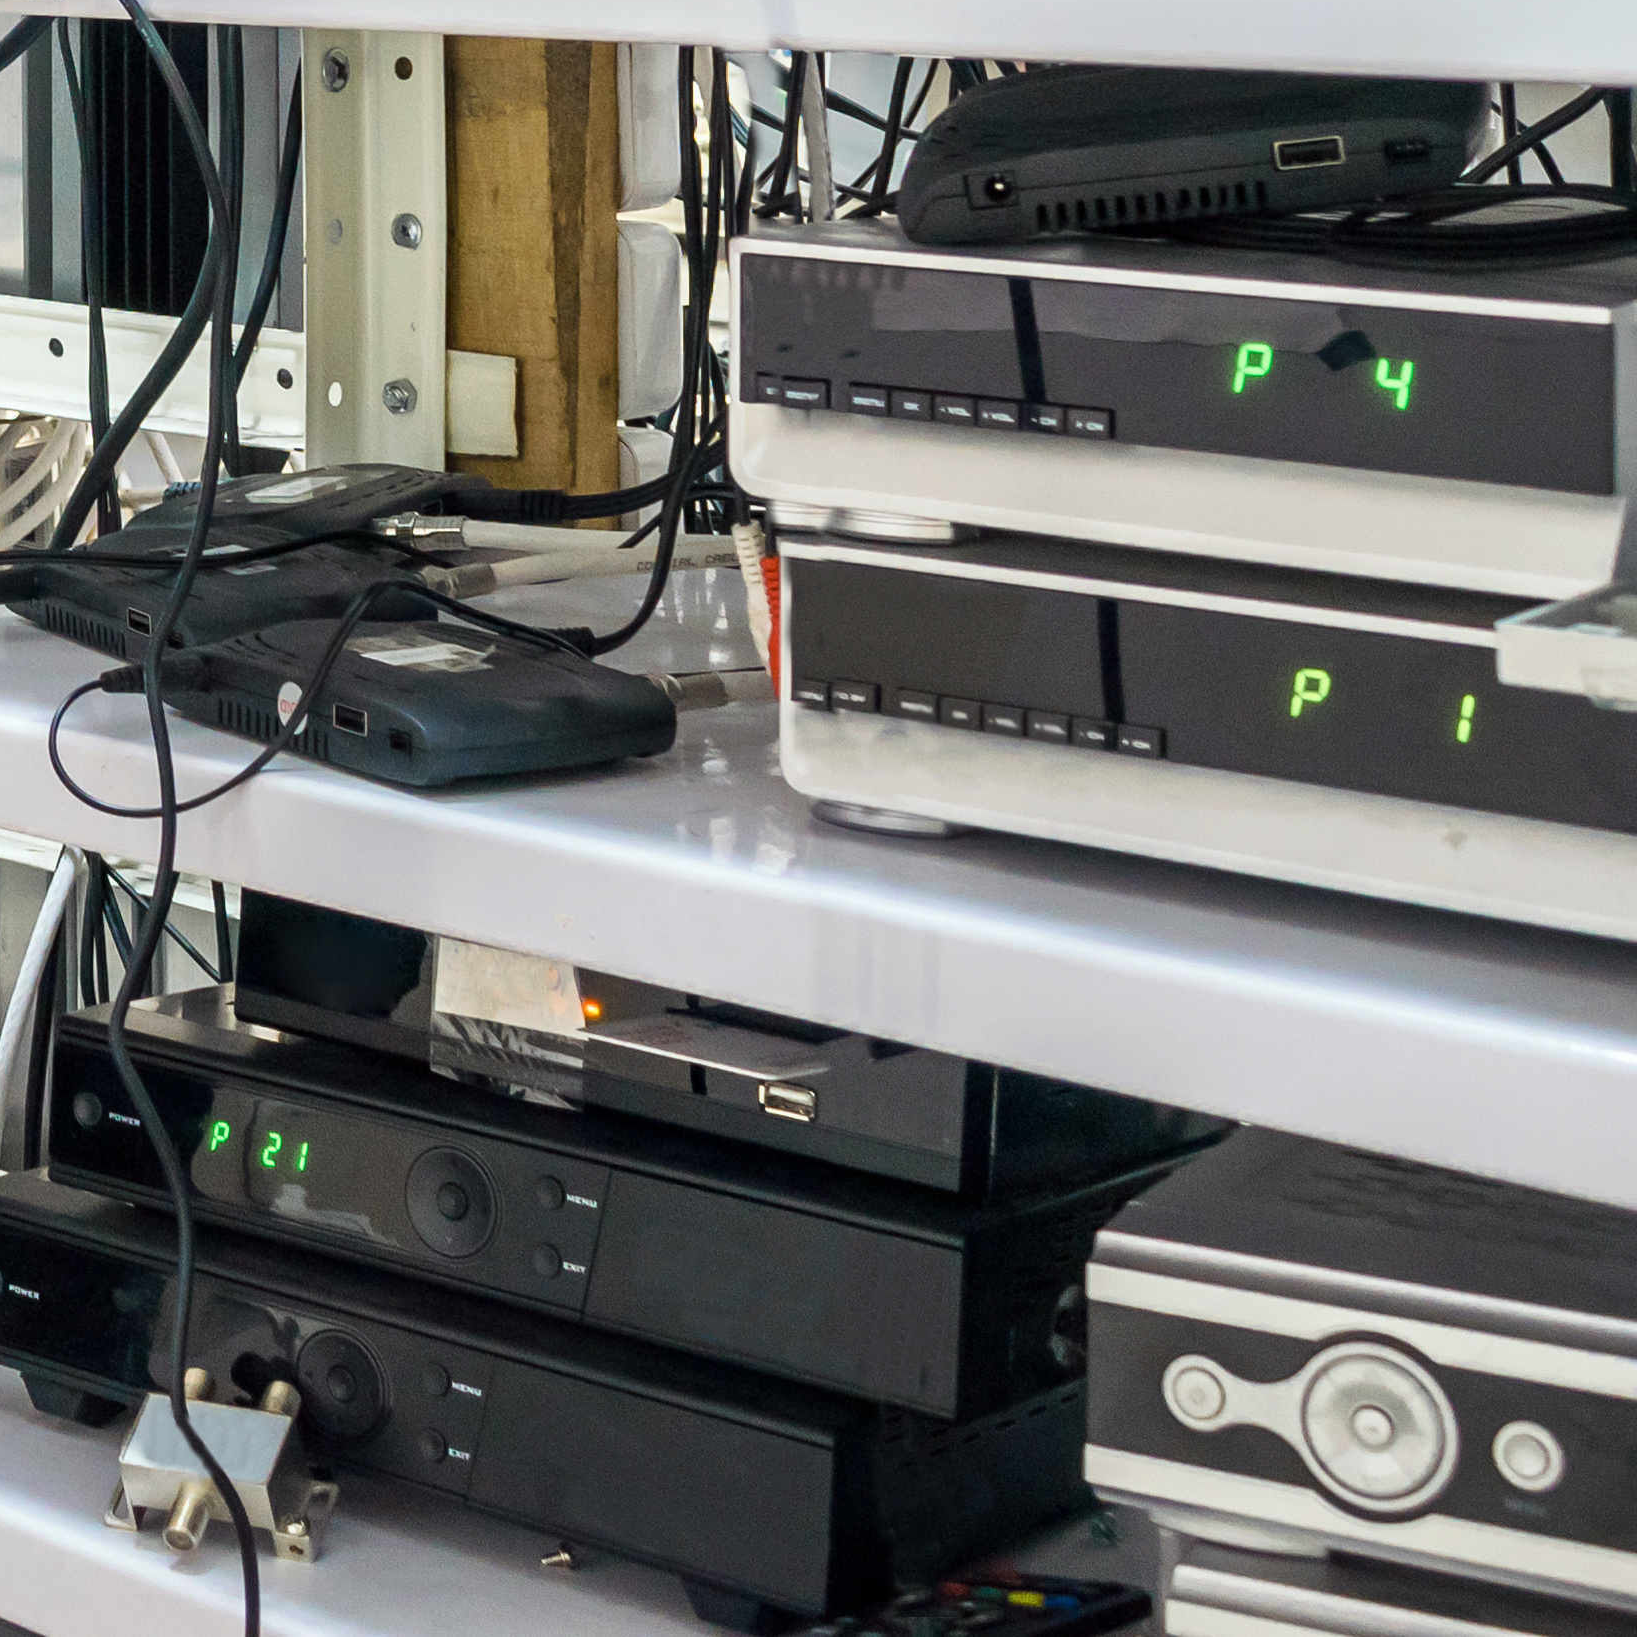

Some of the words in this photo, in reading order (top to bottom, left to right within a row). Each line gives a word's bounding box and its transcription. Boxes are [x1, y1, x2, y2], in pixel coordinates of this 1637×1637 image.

[1233, 342, 1274, 394] P
[1376, 357, 1415, 410] 4
[1290, 668, 1331, 718] P
[1456, 694, 1475, 743] 1
[108, 1112, 141, 1127] POWER
[210, 1121, 230, 1151] P
[262, 1131, 309, 1171] 21
[566, 1193, 598, 1209] MENU
[8, 1284, 40, 1301] POWER
[451, 1380, 482, 1397] MENU
